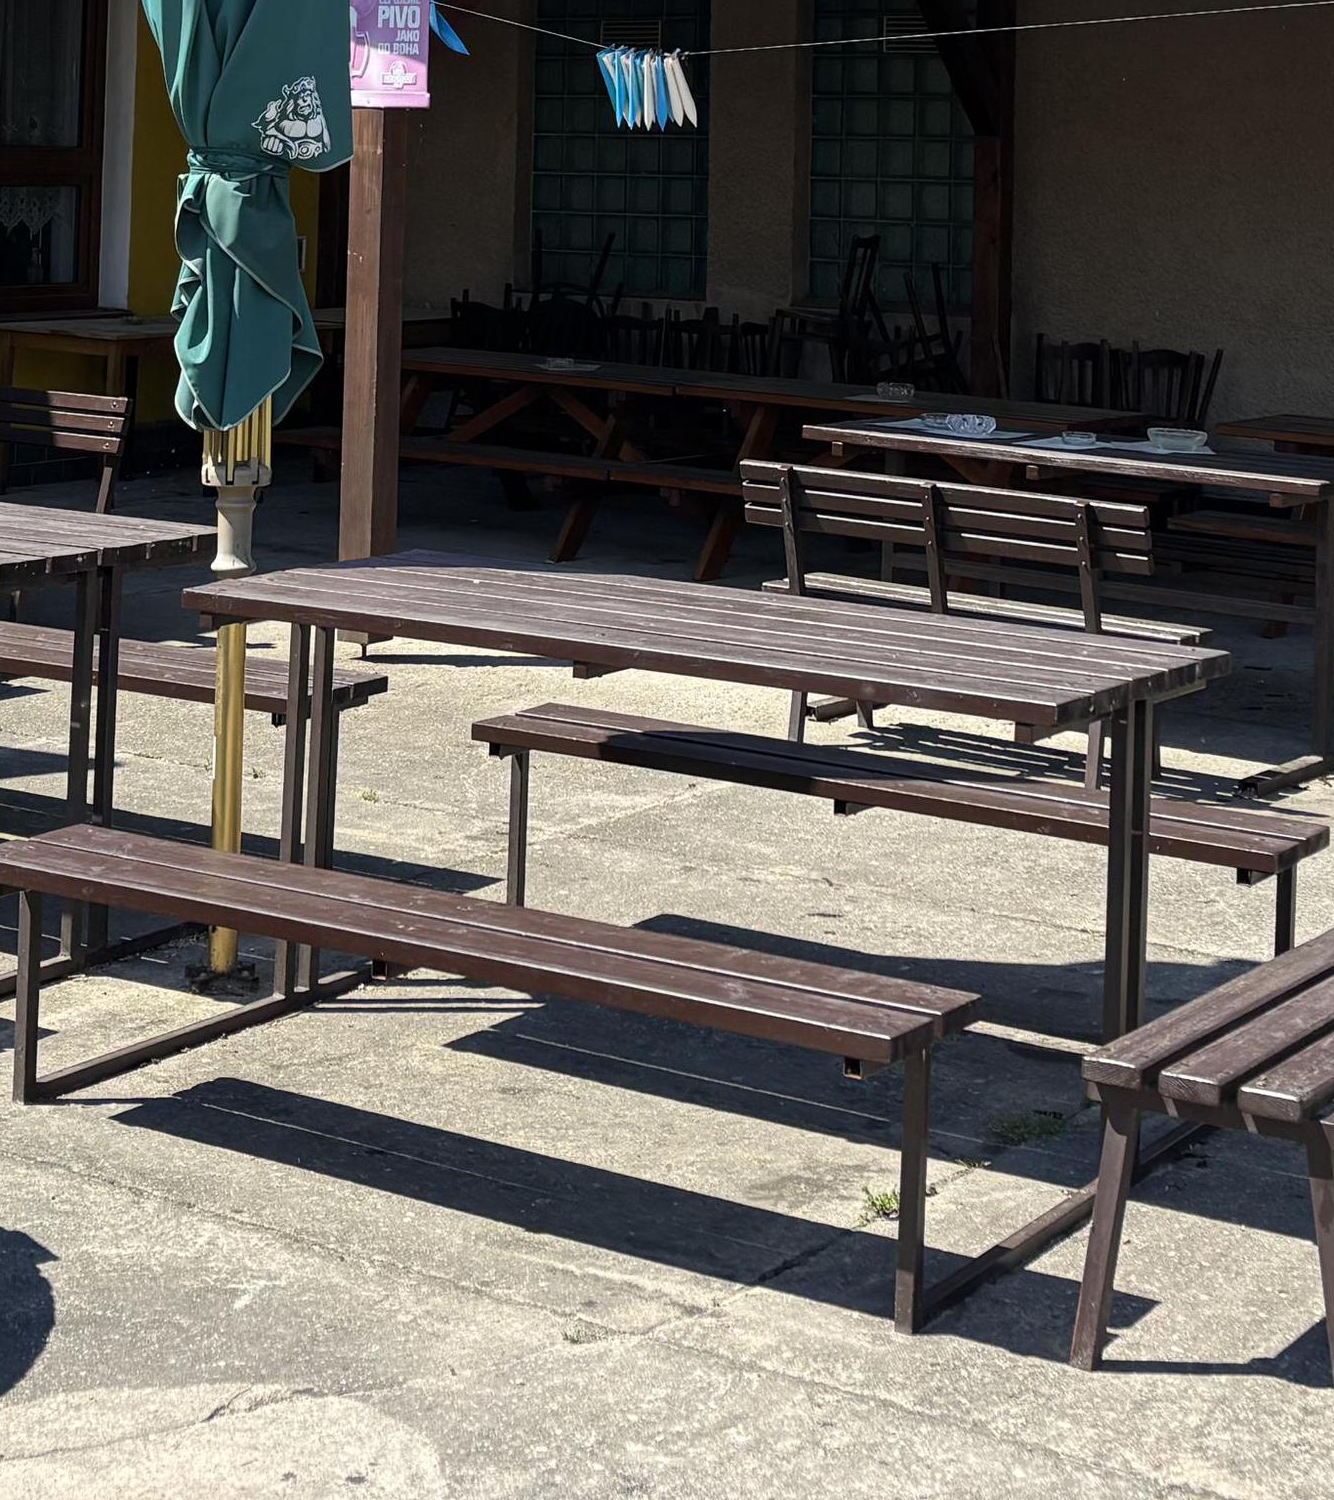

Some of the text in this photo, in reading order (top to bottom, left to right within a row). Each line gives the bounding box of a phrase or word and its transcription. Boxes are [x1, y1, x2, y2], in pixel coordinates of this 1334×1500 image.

[378, 5, 421, 28] PIVO
[395, 29, 420, 42] JAKO
[378, 42, 419, 55] OD BOHA
